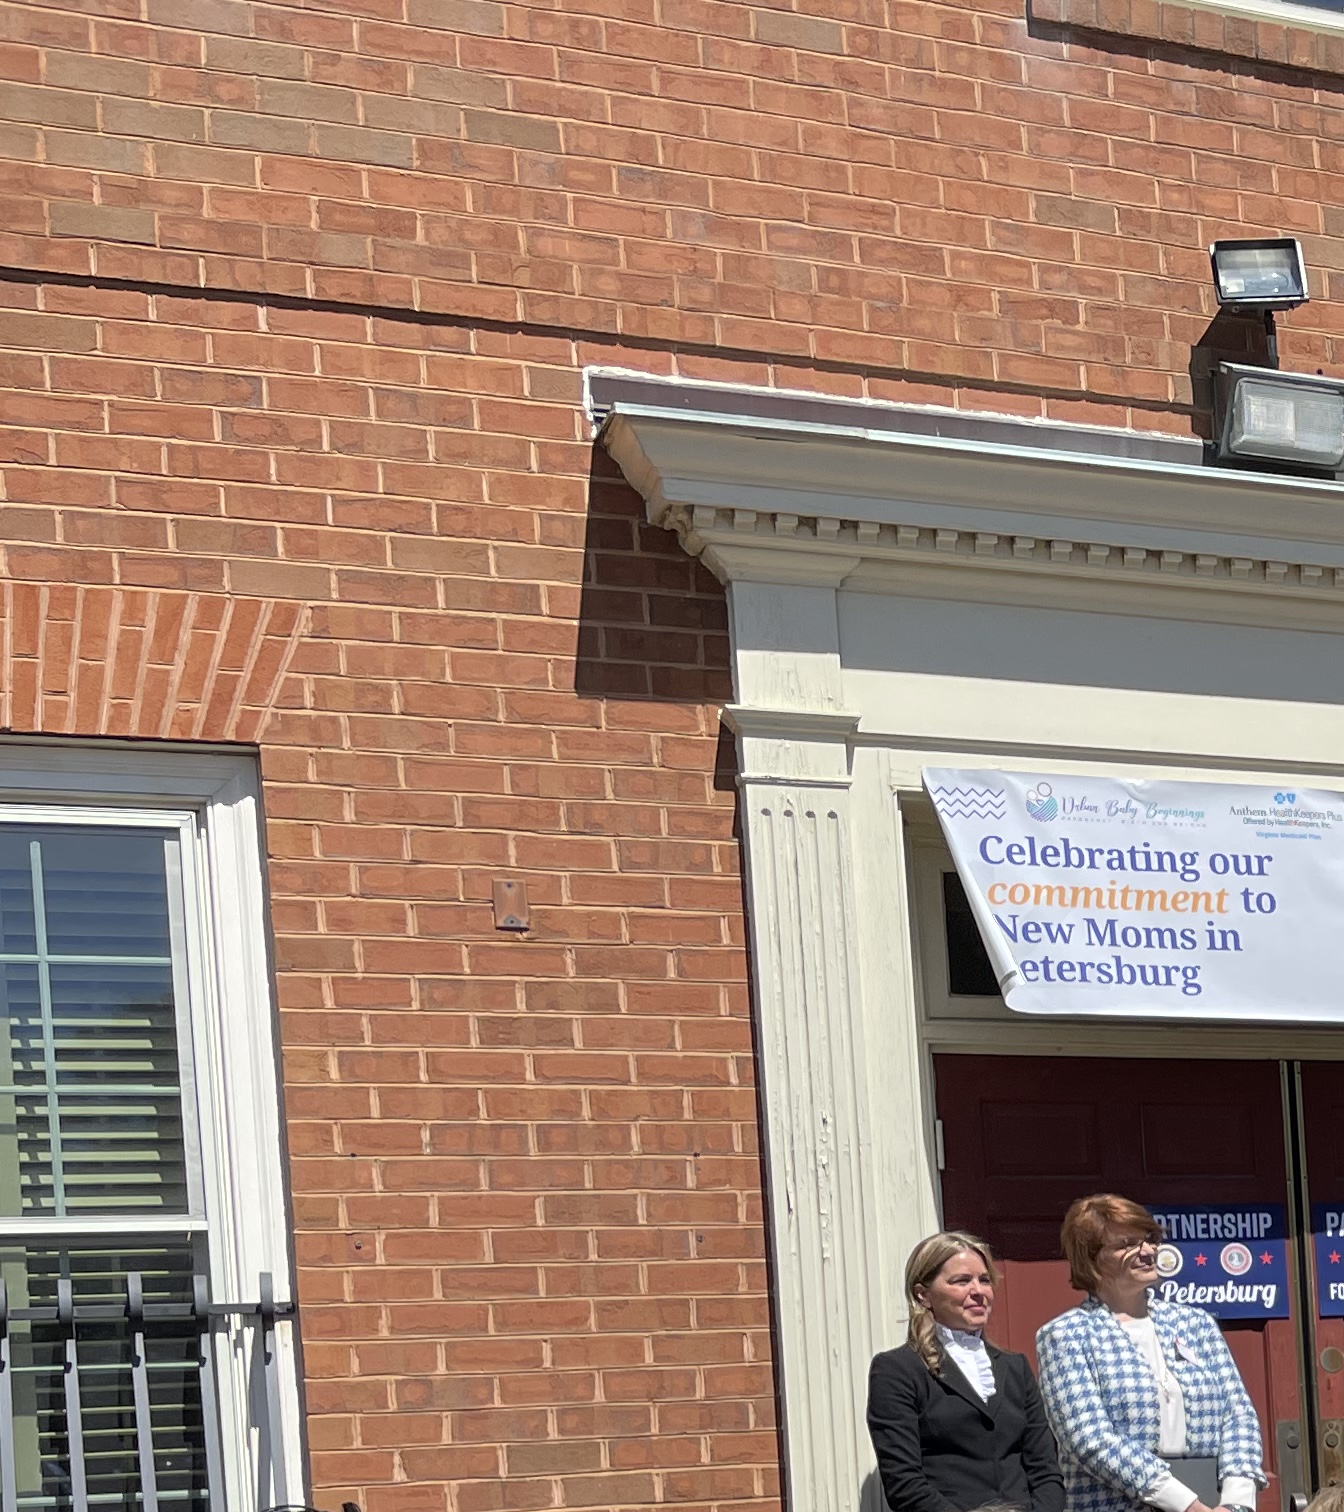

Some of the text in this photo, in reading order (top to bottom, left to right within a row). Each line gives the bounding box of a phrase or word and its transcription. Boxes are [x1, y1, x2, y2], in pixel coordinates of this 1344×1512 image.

[1062, 796, 1205, 822] Urban Baby Beginnings
[1243, 817, 1266, 826] Offered
[1267, 819, 1274, 827] by
[1269, 807, 1326, 820] HealthKeepers
[1327, 810, 1343, 821] Plus
[979, 835, 1273, 882] Celebrating our
[987, 880, 1277, 914] commitment to
[992, 913, 1243, 951] New Moms in
[1018, 955, 1203, 996] etersburg
[1153, 1212, 1272, 1239] RTNERSHIP
[1160, 1280, 1277, 1309] Petersburg
